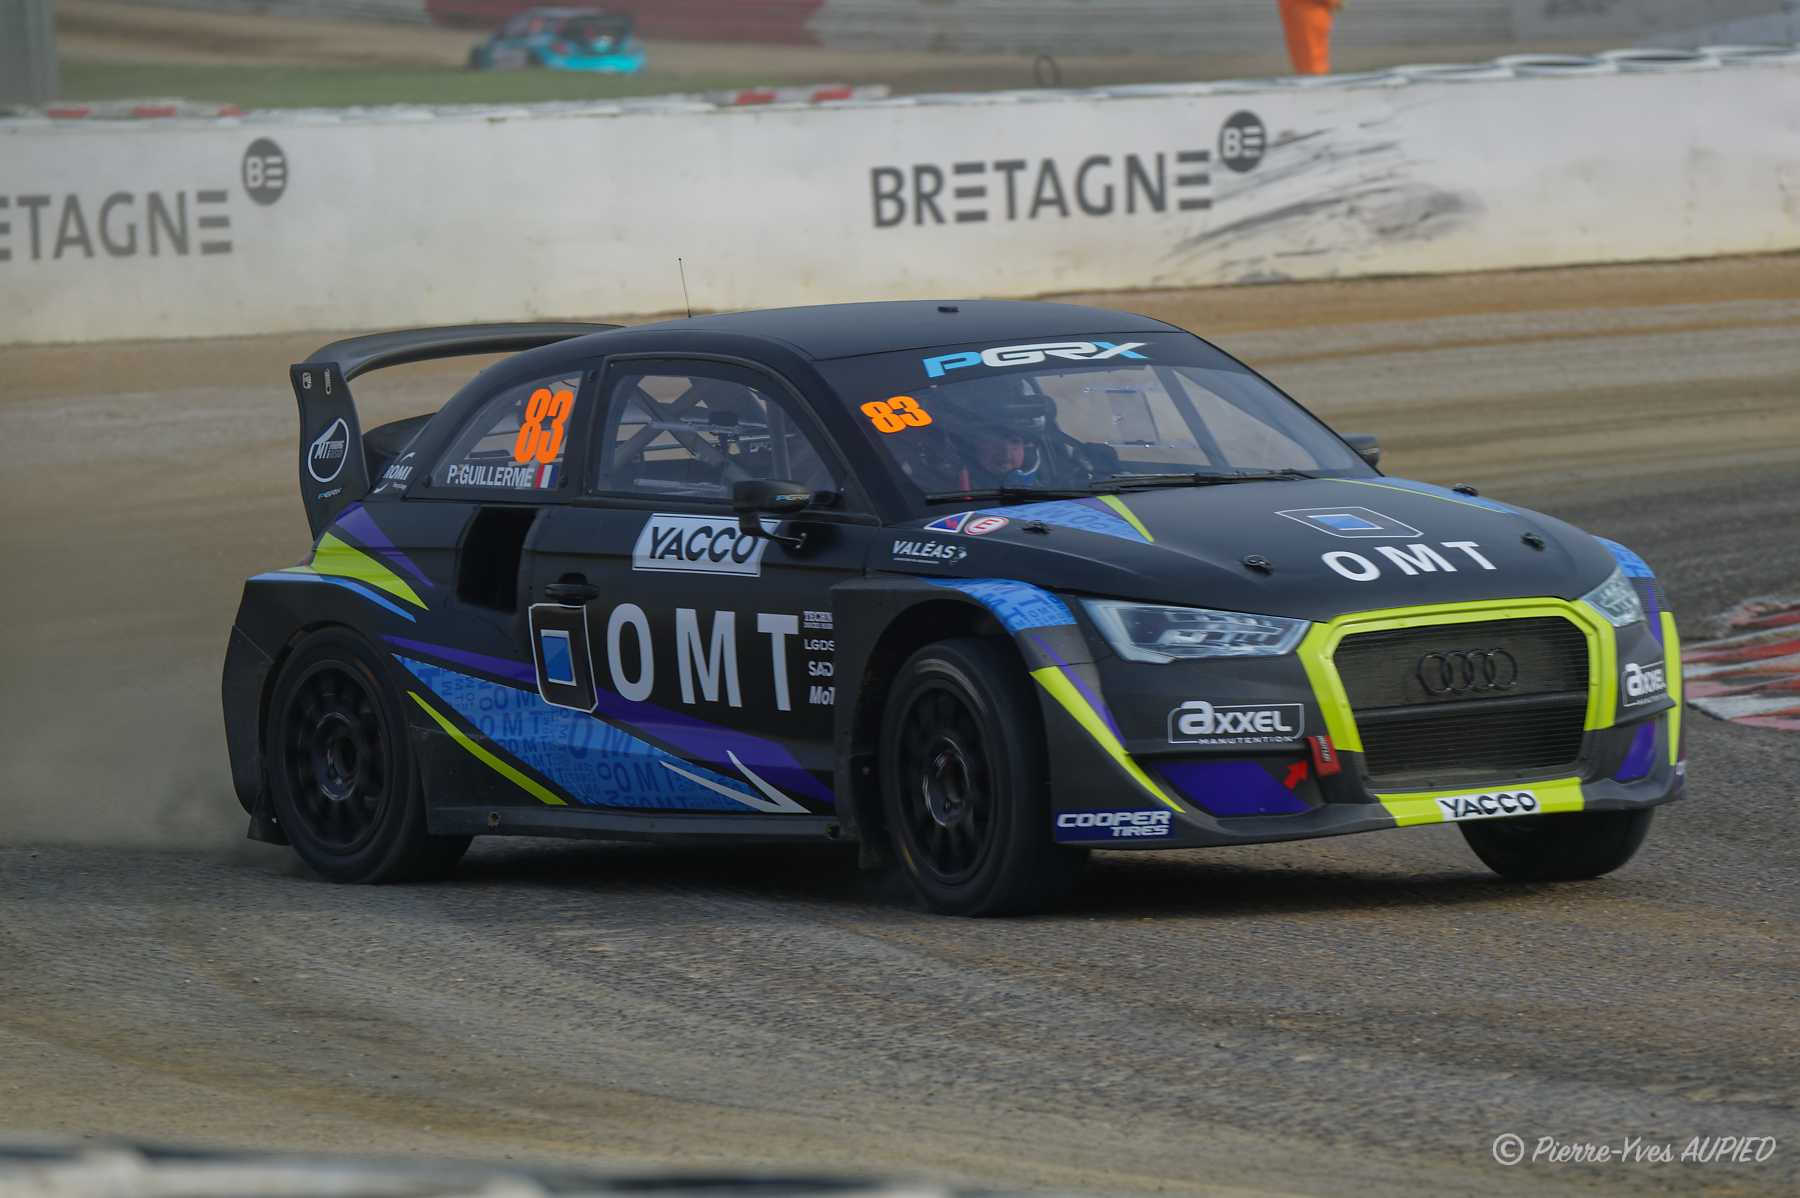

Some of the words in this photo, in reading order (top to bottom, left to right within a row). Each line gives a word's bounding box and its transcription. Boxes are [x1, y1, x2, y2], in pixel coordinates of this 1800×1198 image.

[870, 150, 1213, 229] BRETAGNE
[922, 341, 1150, 378] PGRX
[513, 387, 575, 465] 83
[860, 395, 934, 435] 83
[446, 463, 535, 488] P.GUILLERME
[649, 525, 759, 564] YACCO
[892, 539, 958, 559] VALÉAS
[1321, 540, 1497, 582] OMT
[606, 602, 800, 712] OMT
[1057, 811, 1172, 828] COOPER
[1440, 792, 1536, 818] YACCO
[1109, 825, 1170, 837] TIRES
